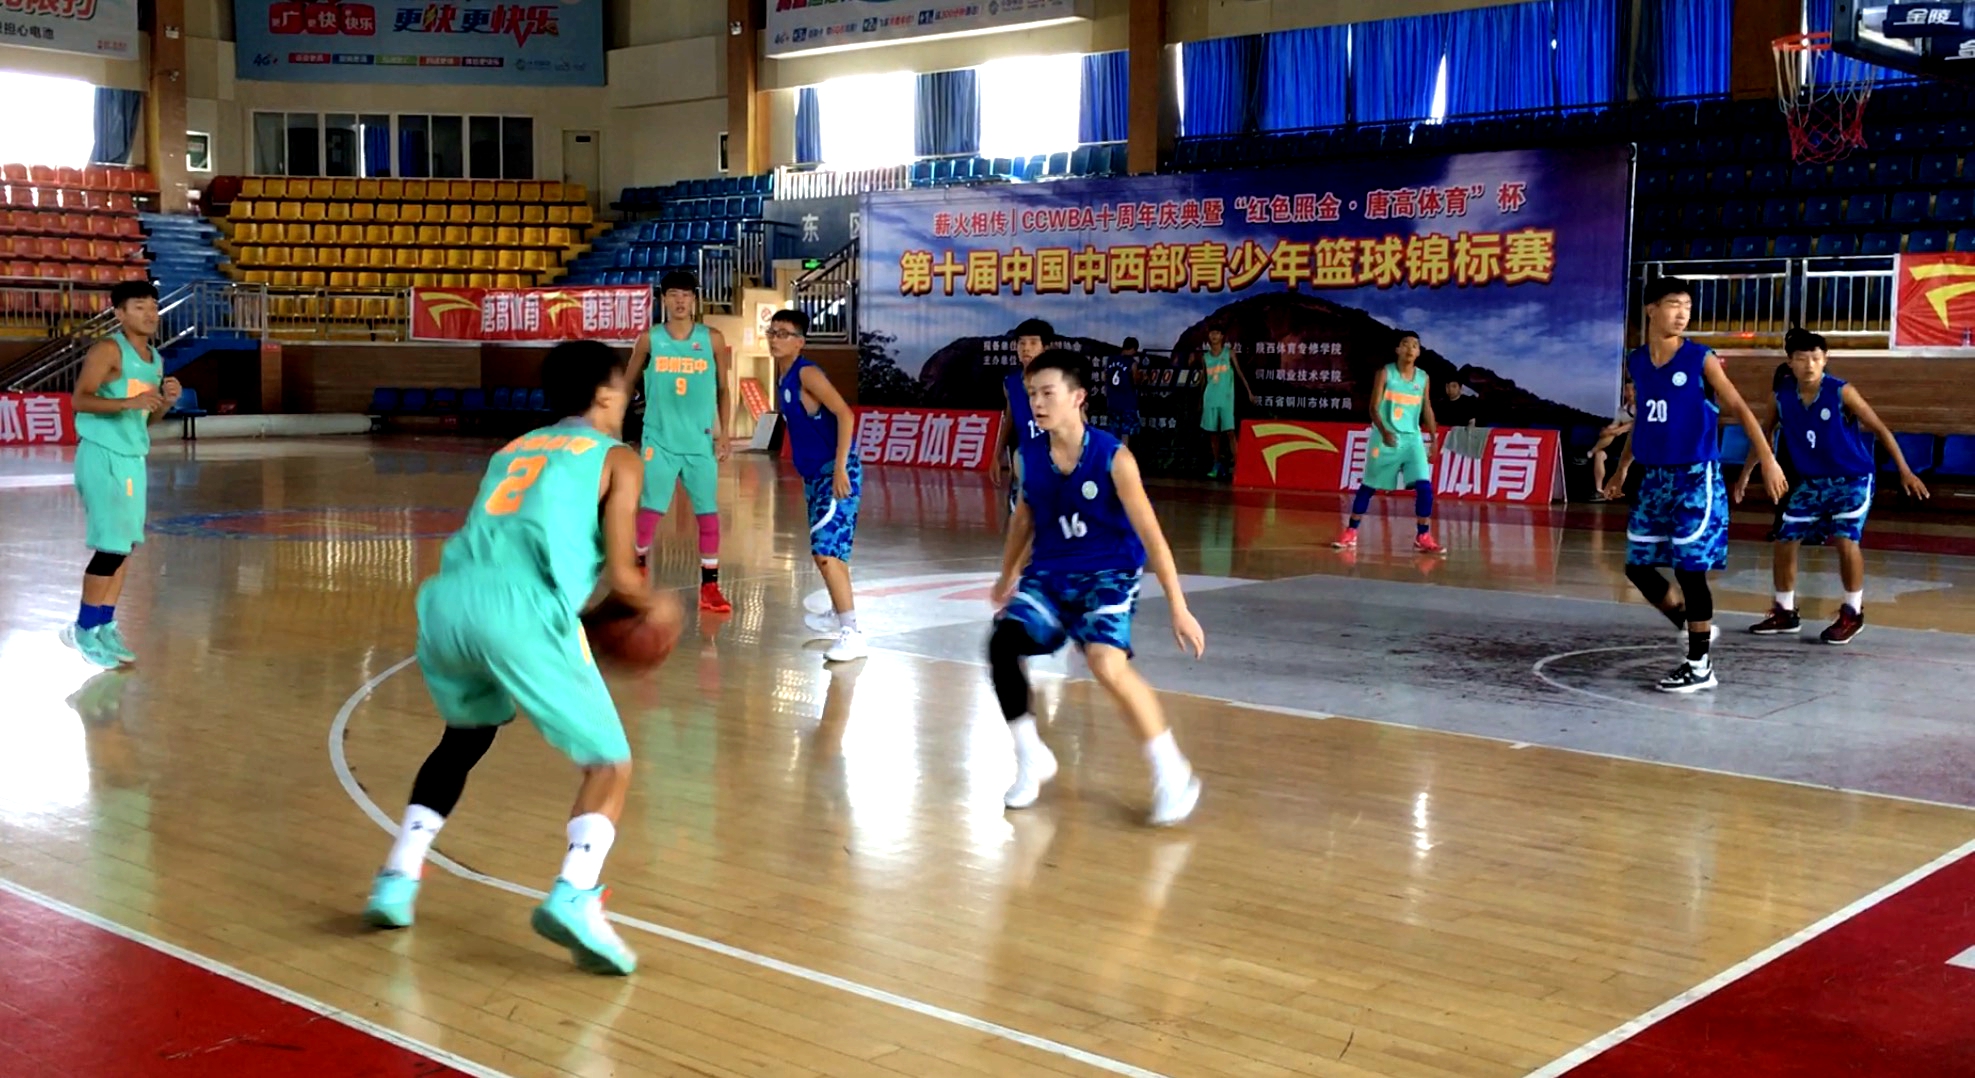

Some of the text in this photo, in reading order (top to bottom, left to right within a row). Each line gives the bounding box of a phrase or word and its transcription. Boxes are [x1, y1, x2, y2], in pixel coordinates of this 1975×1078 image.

[0, 22, 54, 39] 担心电池
[900, 227, 1555, 297] 第十届中国中西部青少年篮球锦标赛
[480, 290, 647, 333] 唐高体育 唐高体育
[676, 377, 687, 396] 9
[1112, 370, 1120, 386] 6
[1646, 399, 1668, 423] 20
[856, 409, 991, 469] 唐高体育
[1806, 430, 1817, 448] 9
[485, 454, 548, 516] 2
[1059, 512, 1088, 540] 16
